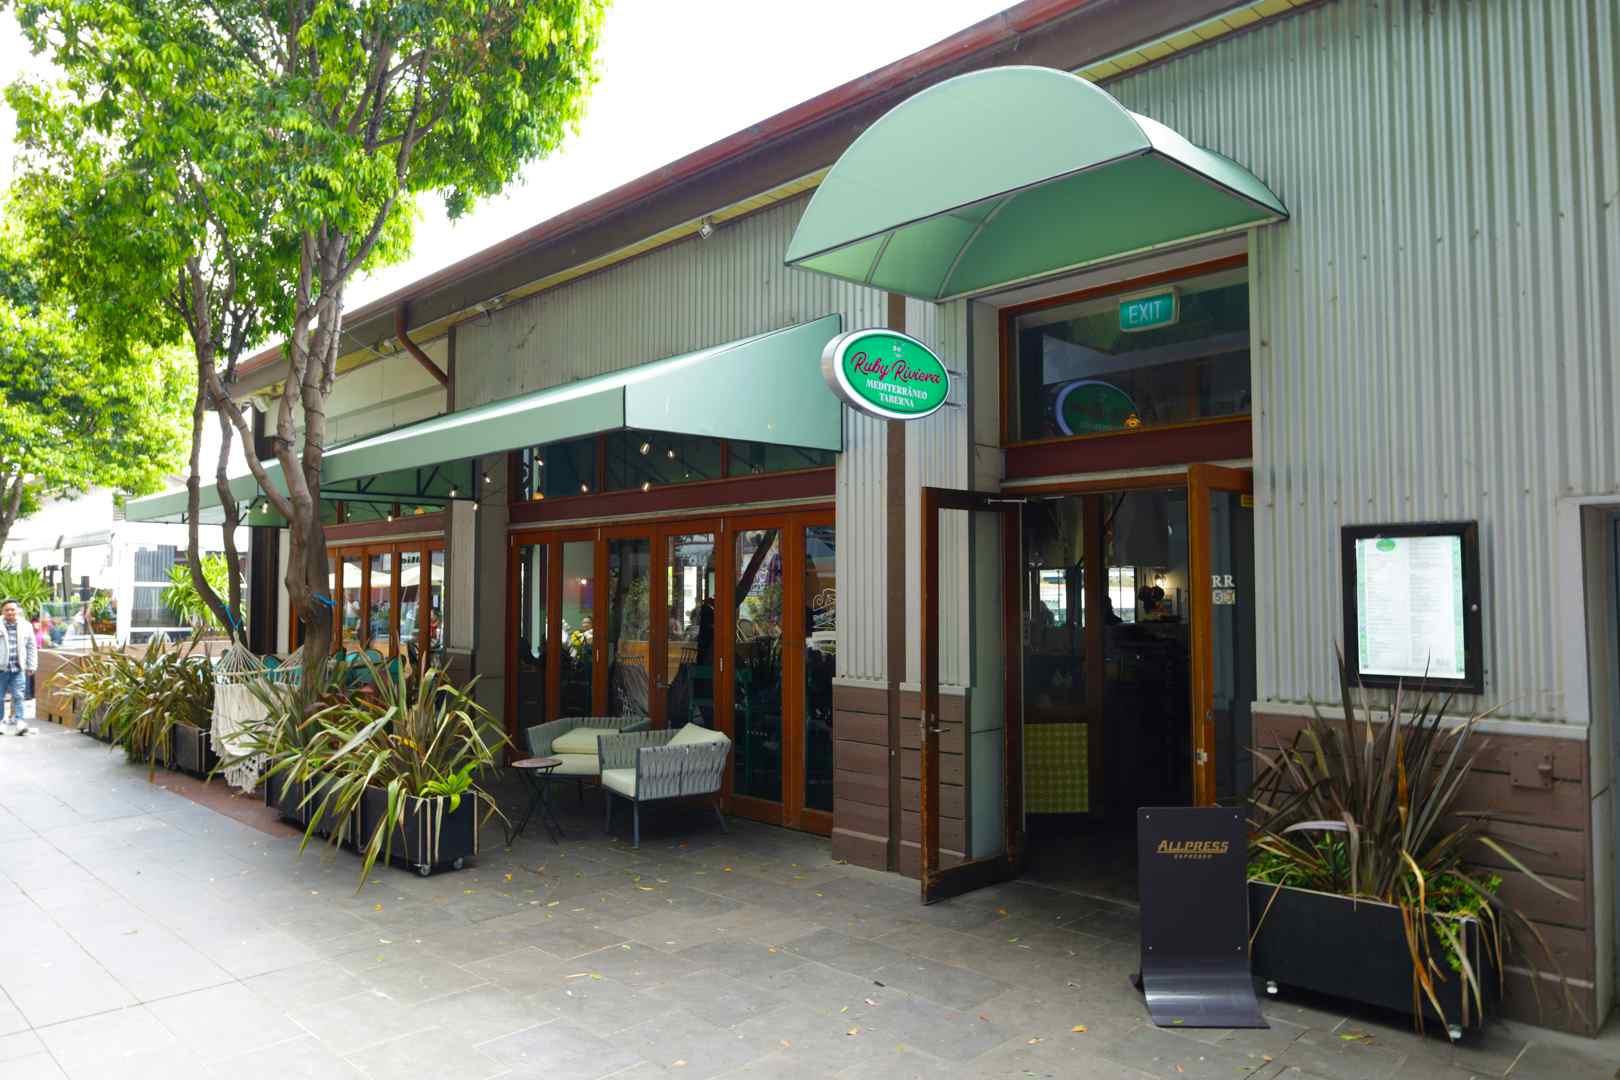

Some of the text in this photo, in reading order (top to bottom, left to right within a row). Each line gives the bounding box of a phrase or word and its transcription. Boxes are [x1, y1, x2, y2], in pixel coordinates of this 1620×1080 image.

[1129, 300, 1162, 323] EXIT
[850, 351, 888, 381] Ruby
[892, 359, 941, 383] Riviera
[880, 393, 915, 407] TABERNA
[1156, 840, 1230, 854] ALLPRESS
